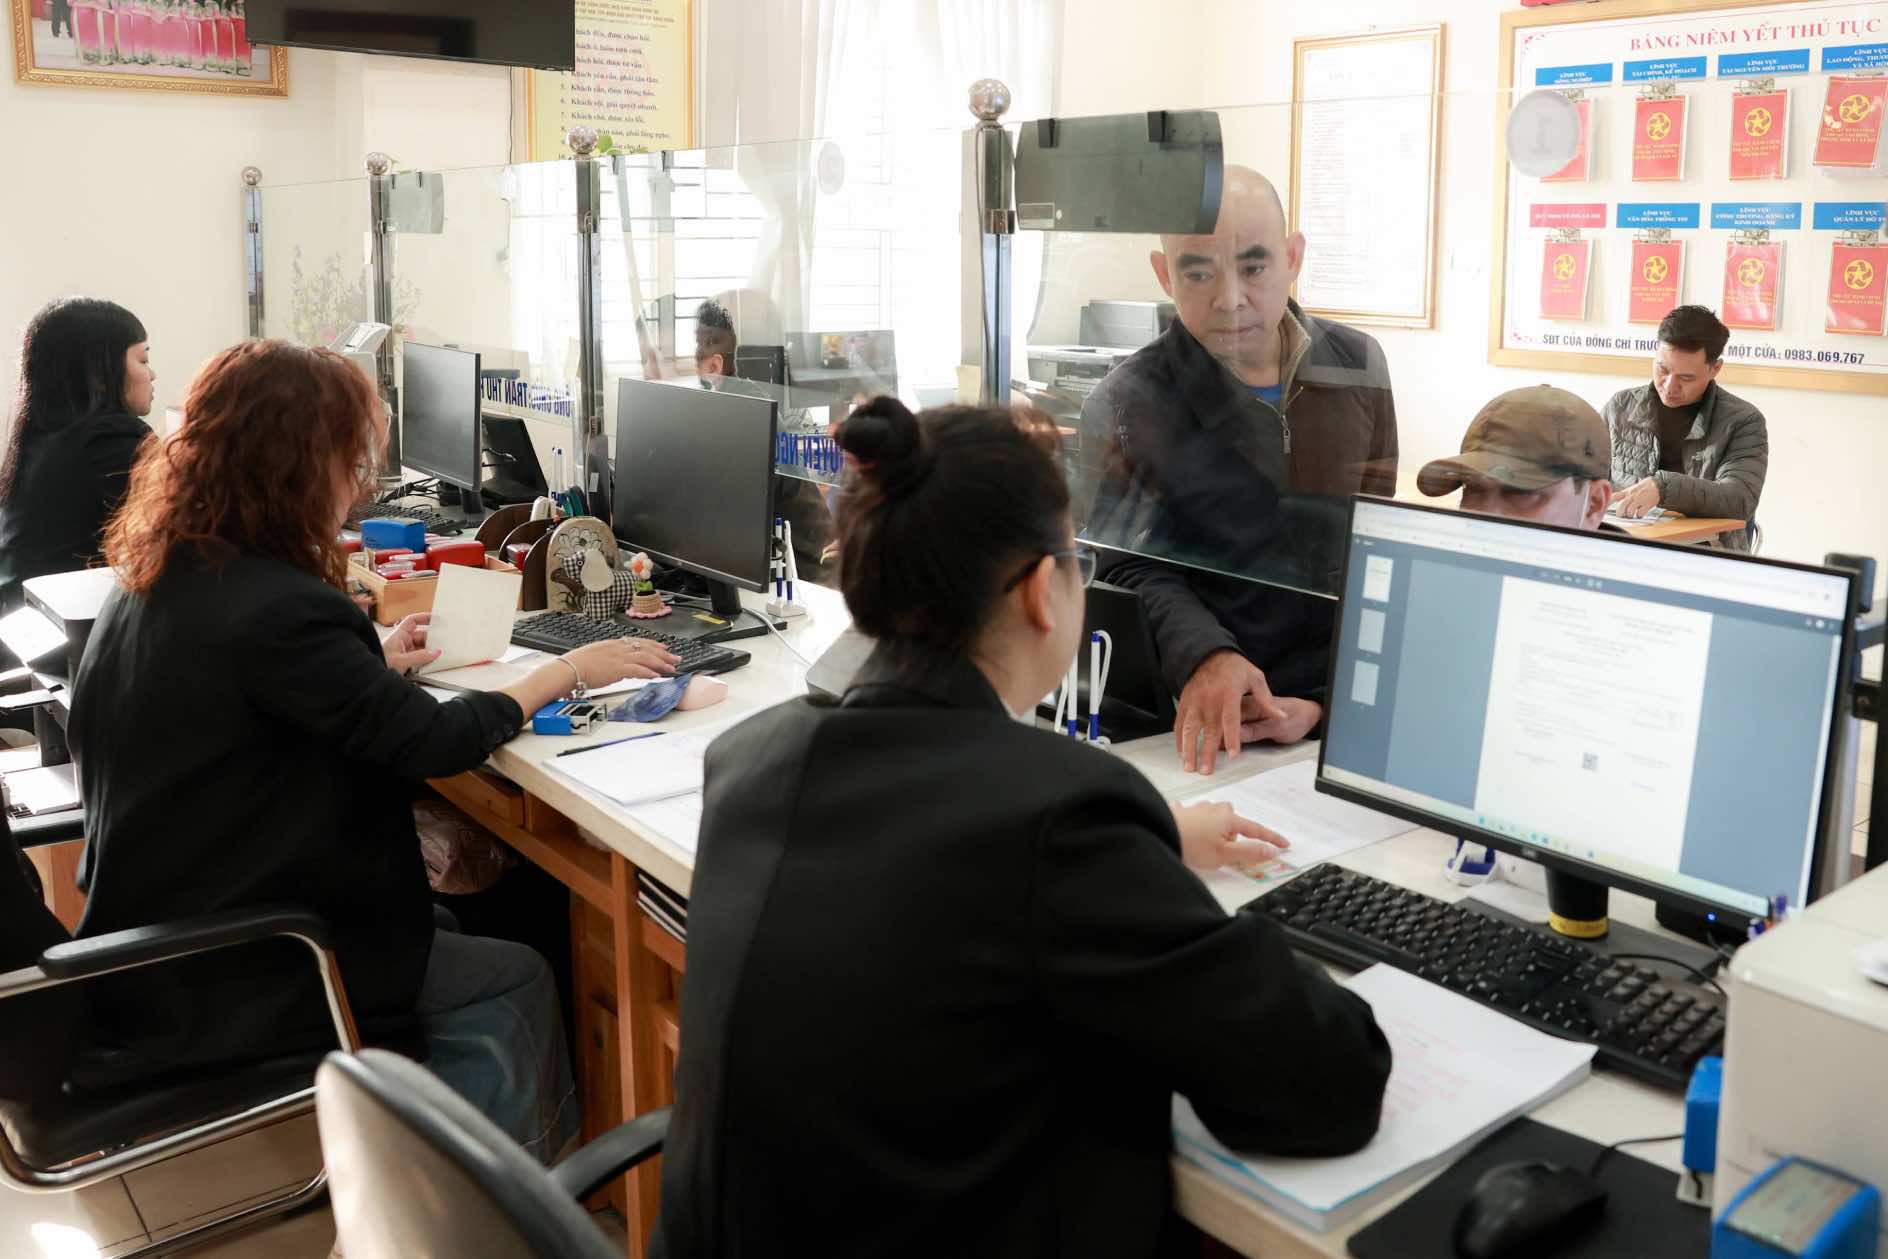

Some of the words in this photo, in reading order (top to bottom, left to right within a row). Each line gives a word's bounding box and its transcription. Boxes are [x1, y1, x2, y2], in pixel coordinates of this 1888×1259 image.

[1630, 33, 1679, 51] BẢNG
[1742, 20, 1782, 41] YẾT
[1786, 18, 1829, 38] THỦ
[1836, 18, 1880, 38] TỤC
[1784, 347, 1865, 365] 0983.069.767
